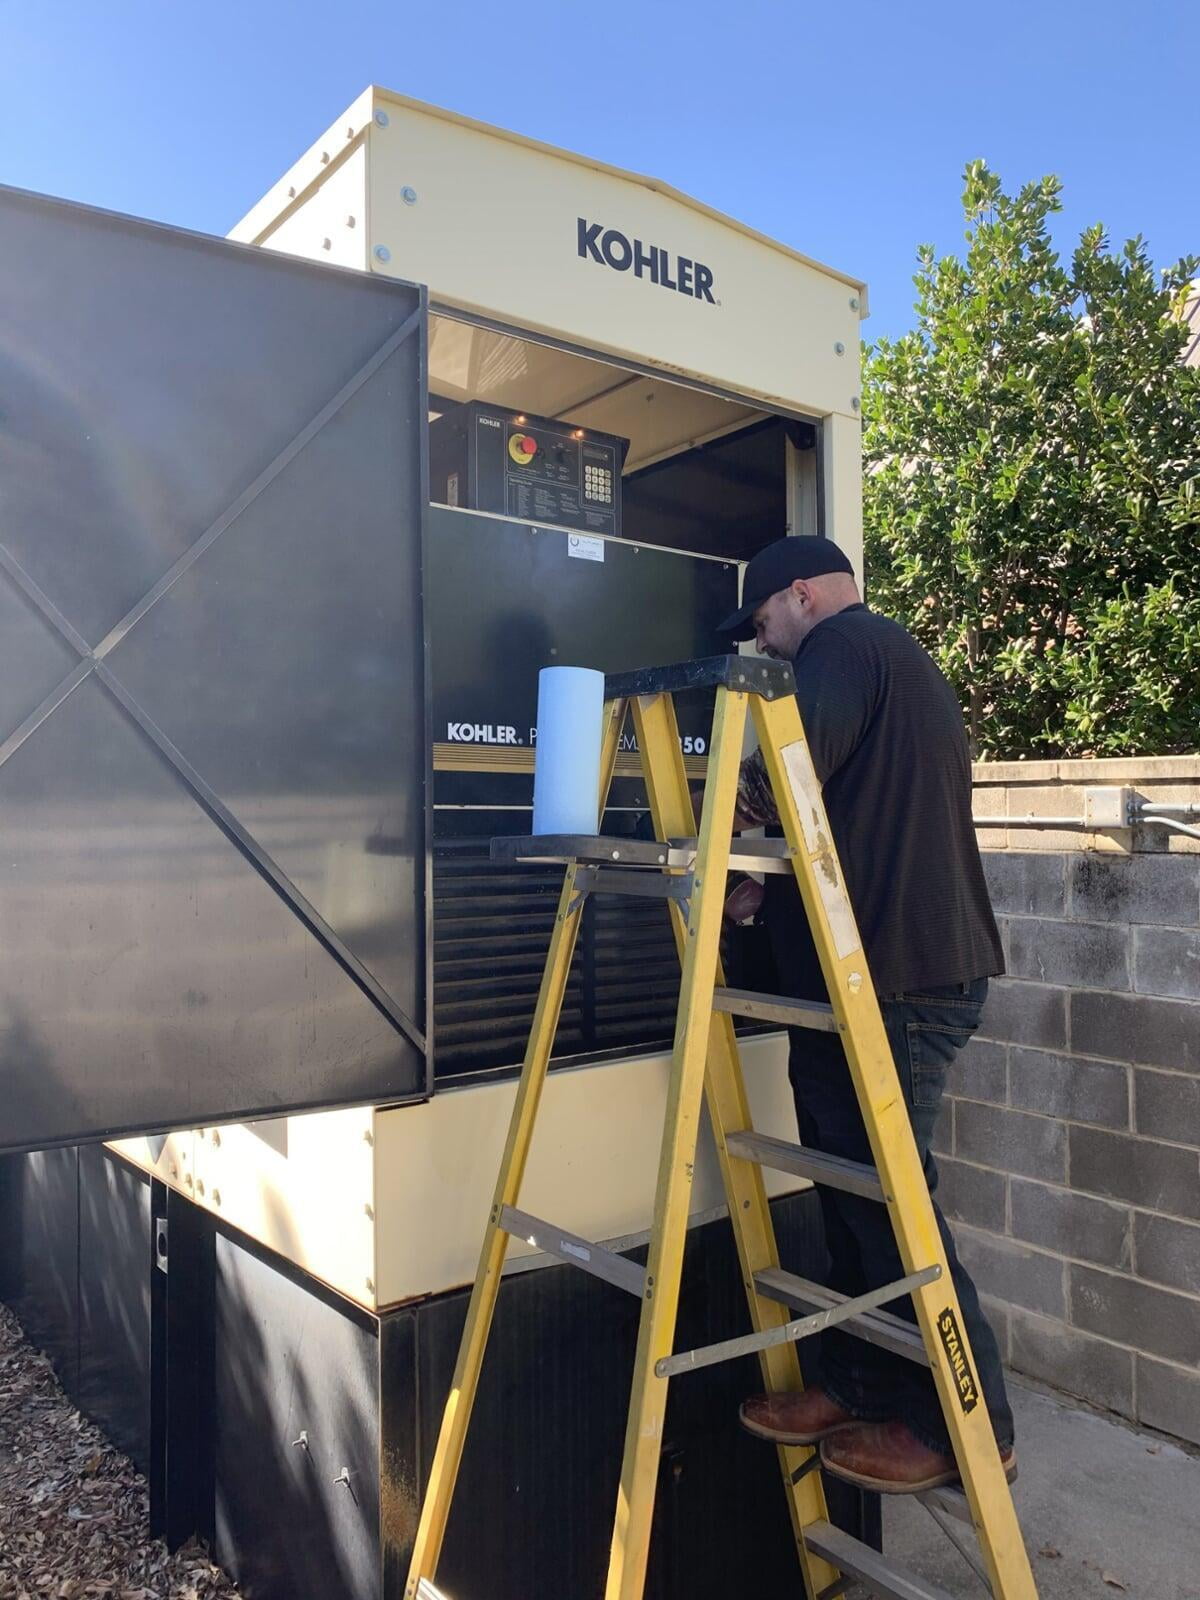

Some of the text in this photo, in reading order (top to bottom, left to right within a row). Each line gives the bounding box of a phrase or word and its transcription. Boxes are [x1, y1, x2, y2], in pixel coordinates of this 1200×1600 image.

[577, 217, 716, 305] KOHLER
[479, 417, 500, 428] KOHLER
[447, 722, 517, 744] KOHLER
[941, 1316, 975, 1402] STANLEY
